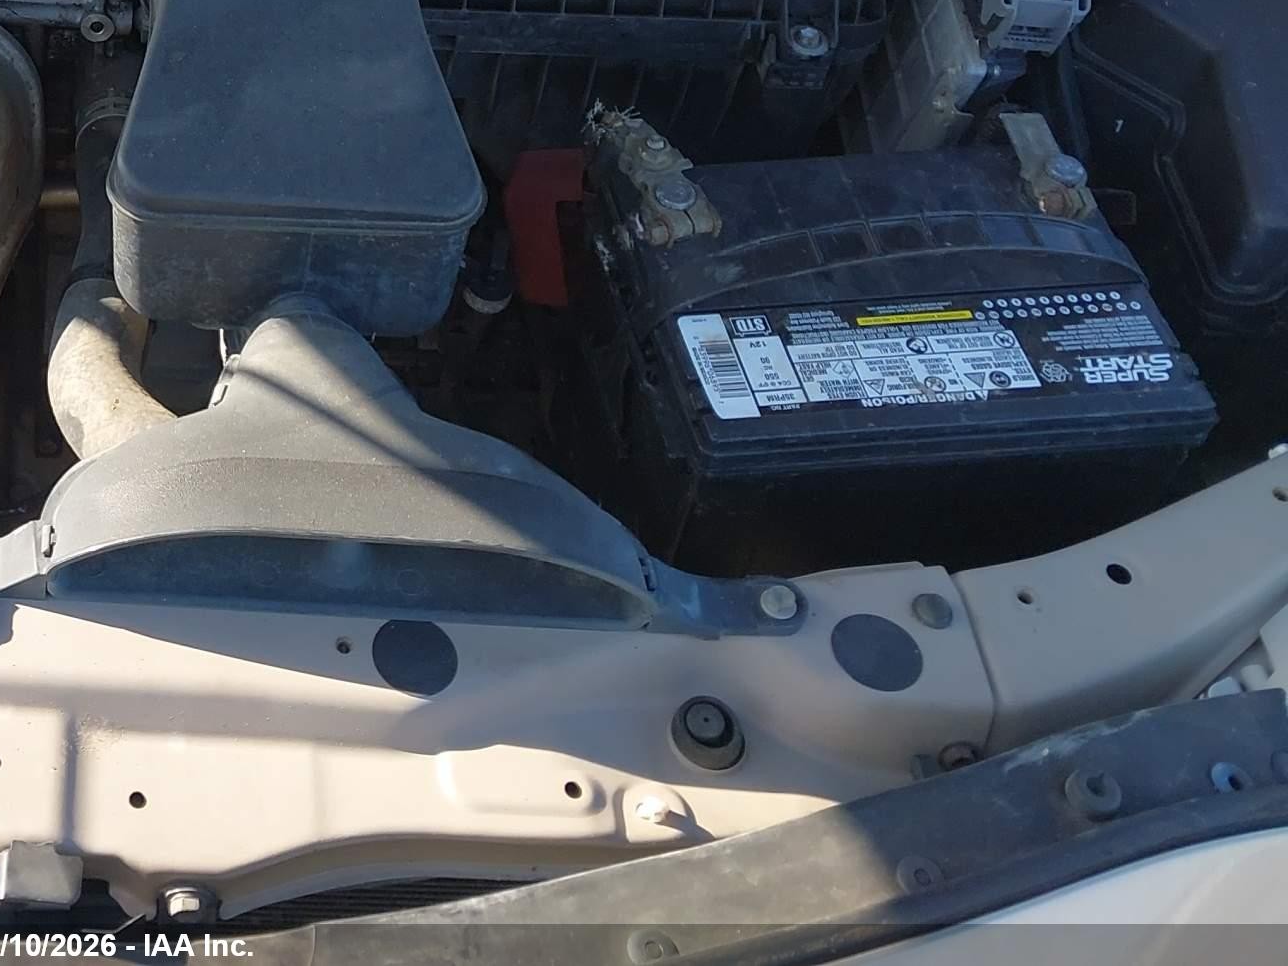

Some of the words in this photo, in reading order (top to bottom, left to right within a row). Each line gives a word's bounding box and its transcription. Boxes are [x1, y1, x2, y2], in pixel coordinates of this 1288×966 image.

[735, 319, 766, 332] STD
[1080, 354, 1173, 370] START
[1084, 366, 1170, 383] SUPER
